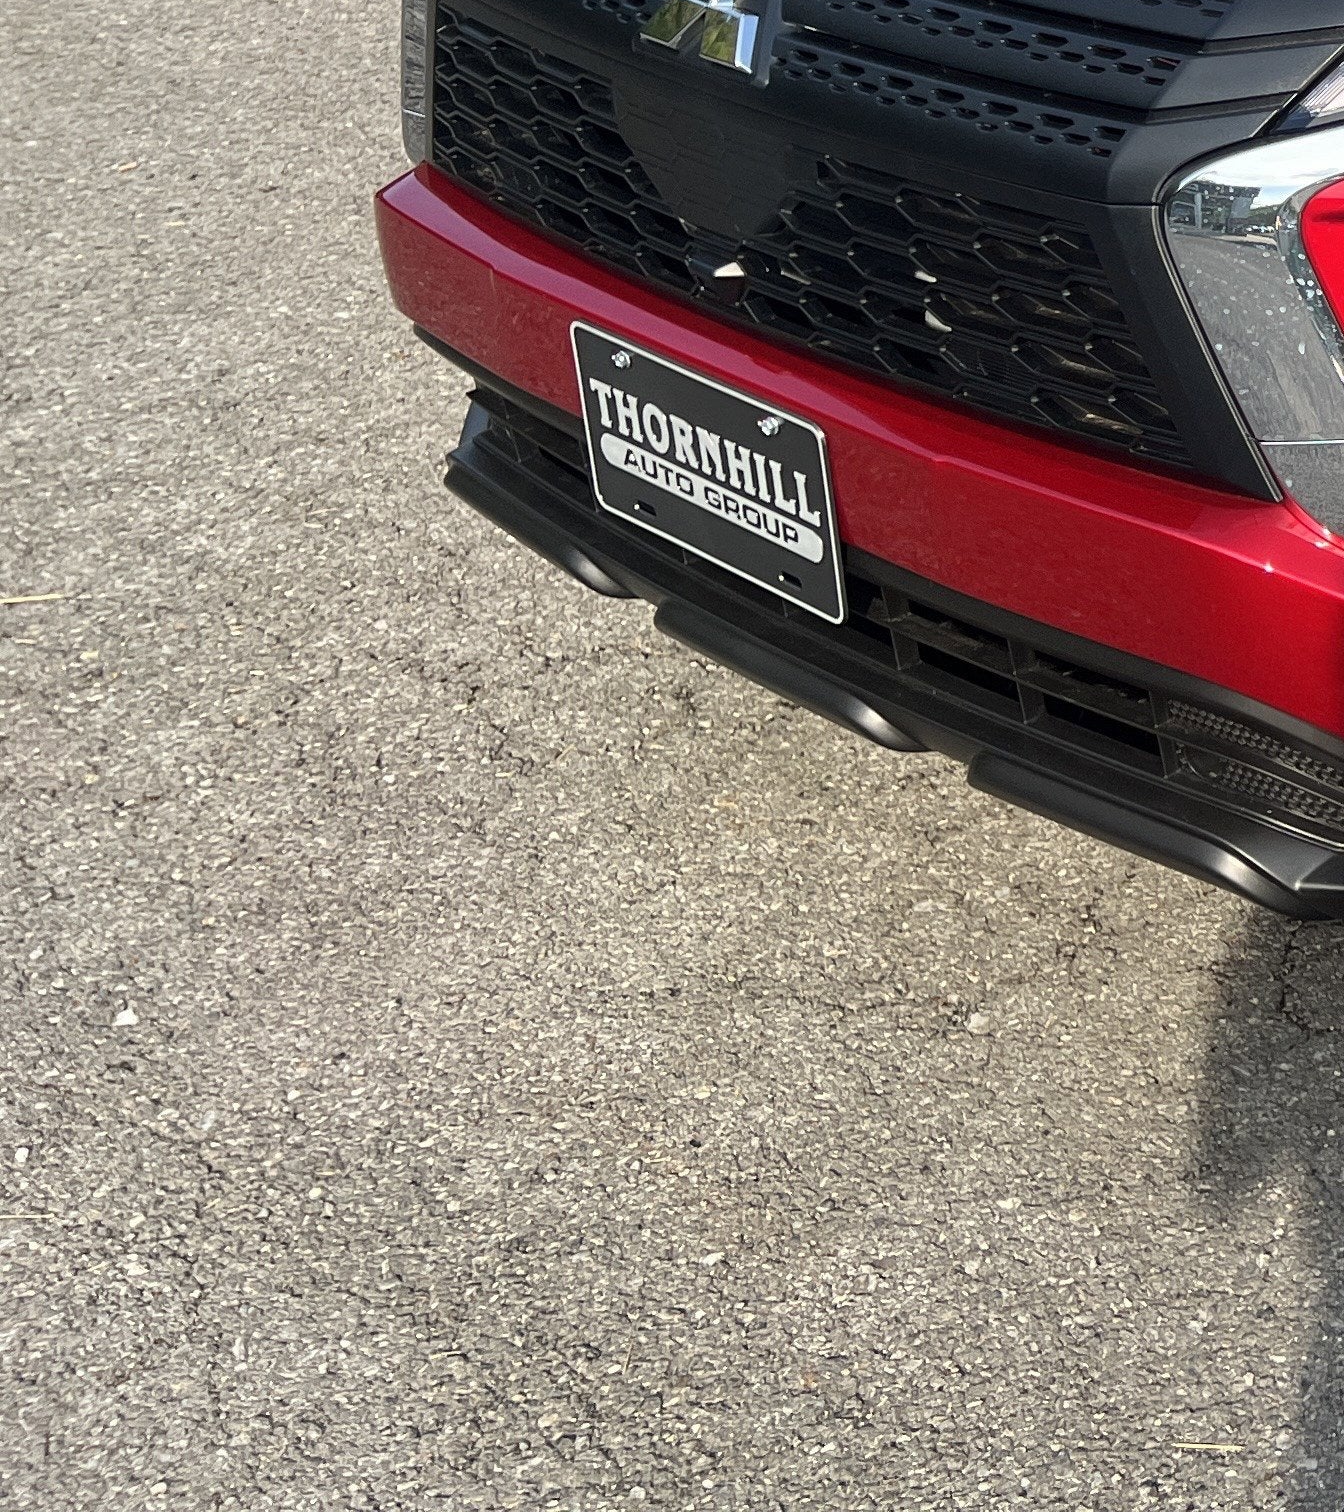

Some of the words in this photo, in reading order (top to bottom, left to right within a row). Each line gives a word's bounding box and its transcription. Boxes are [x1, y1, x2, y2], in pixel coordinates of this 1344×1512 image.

[589, 377, 821, 528] THORNHILL
[623, 448, 694, 497] AUTO
[703, 485, 799, 545] GROUP
